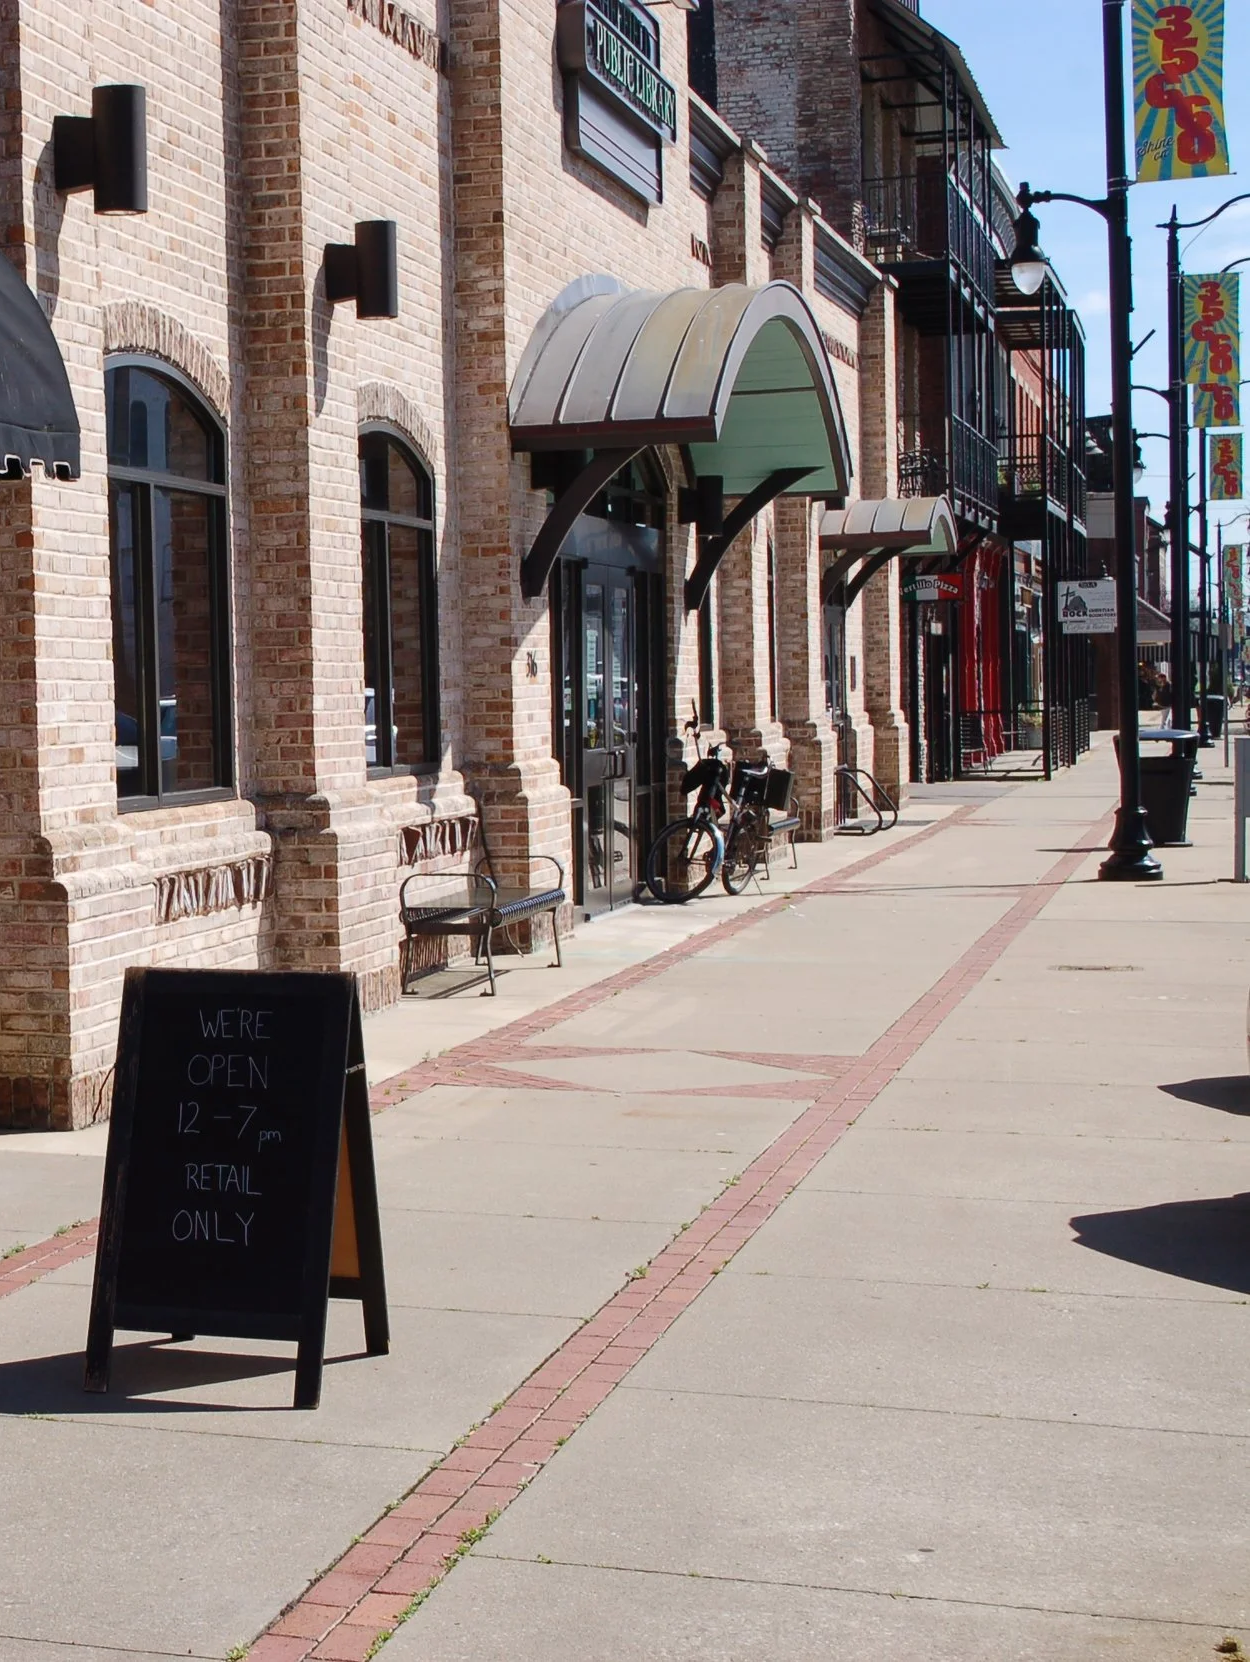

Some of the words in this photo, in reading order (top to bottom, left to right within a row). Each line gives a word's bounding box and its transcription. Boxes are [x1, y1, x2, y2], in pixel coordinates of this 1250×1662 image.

[596, 20, 635, 92] PUBLIC
[635, 58, 676, 131] LIBRARY
[1137, 136, 1174, 158] Shine
[934, 579, 959, 595] Pizza
[199, 1007, 273, 1041] WE'RE
[187, 1053, 269, 1089] OPEN
[178, 1101, 201, 1134] 12
[185, 1163, 262, 1196] RETAIL
[172, 1209, 255, 1246] ONLY
